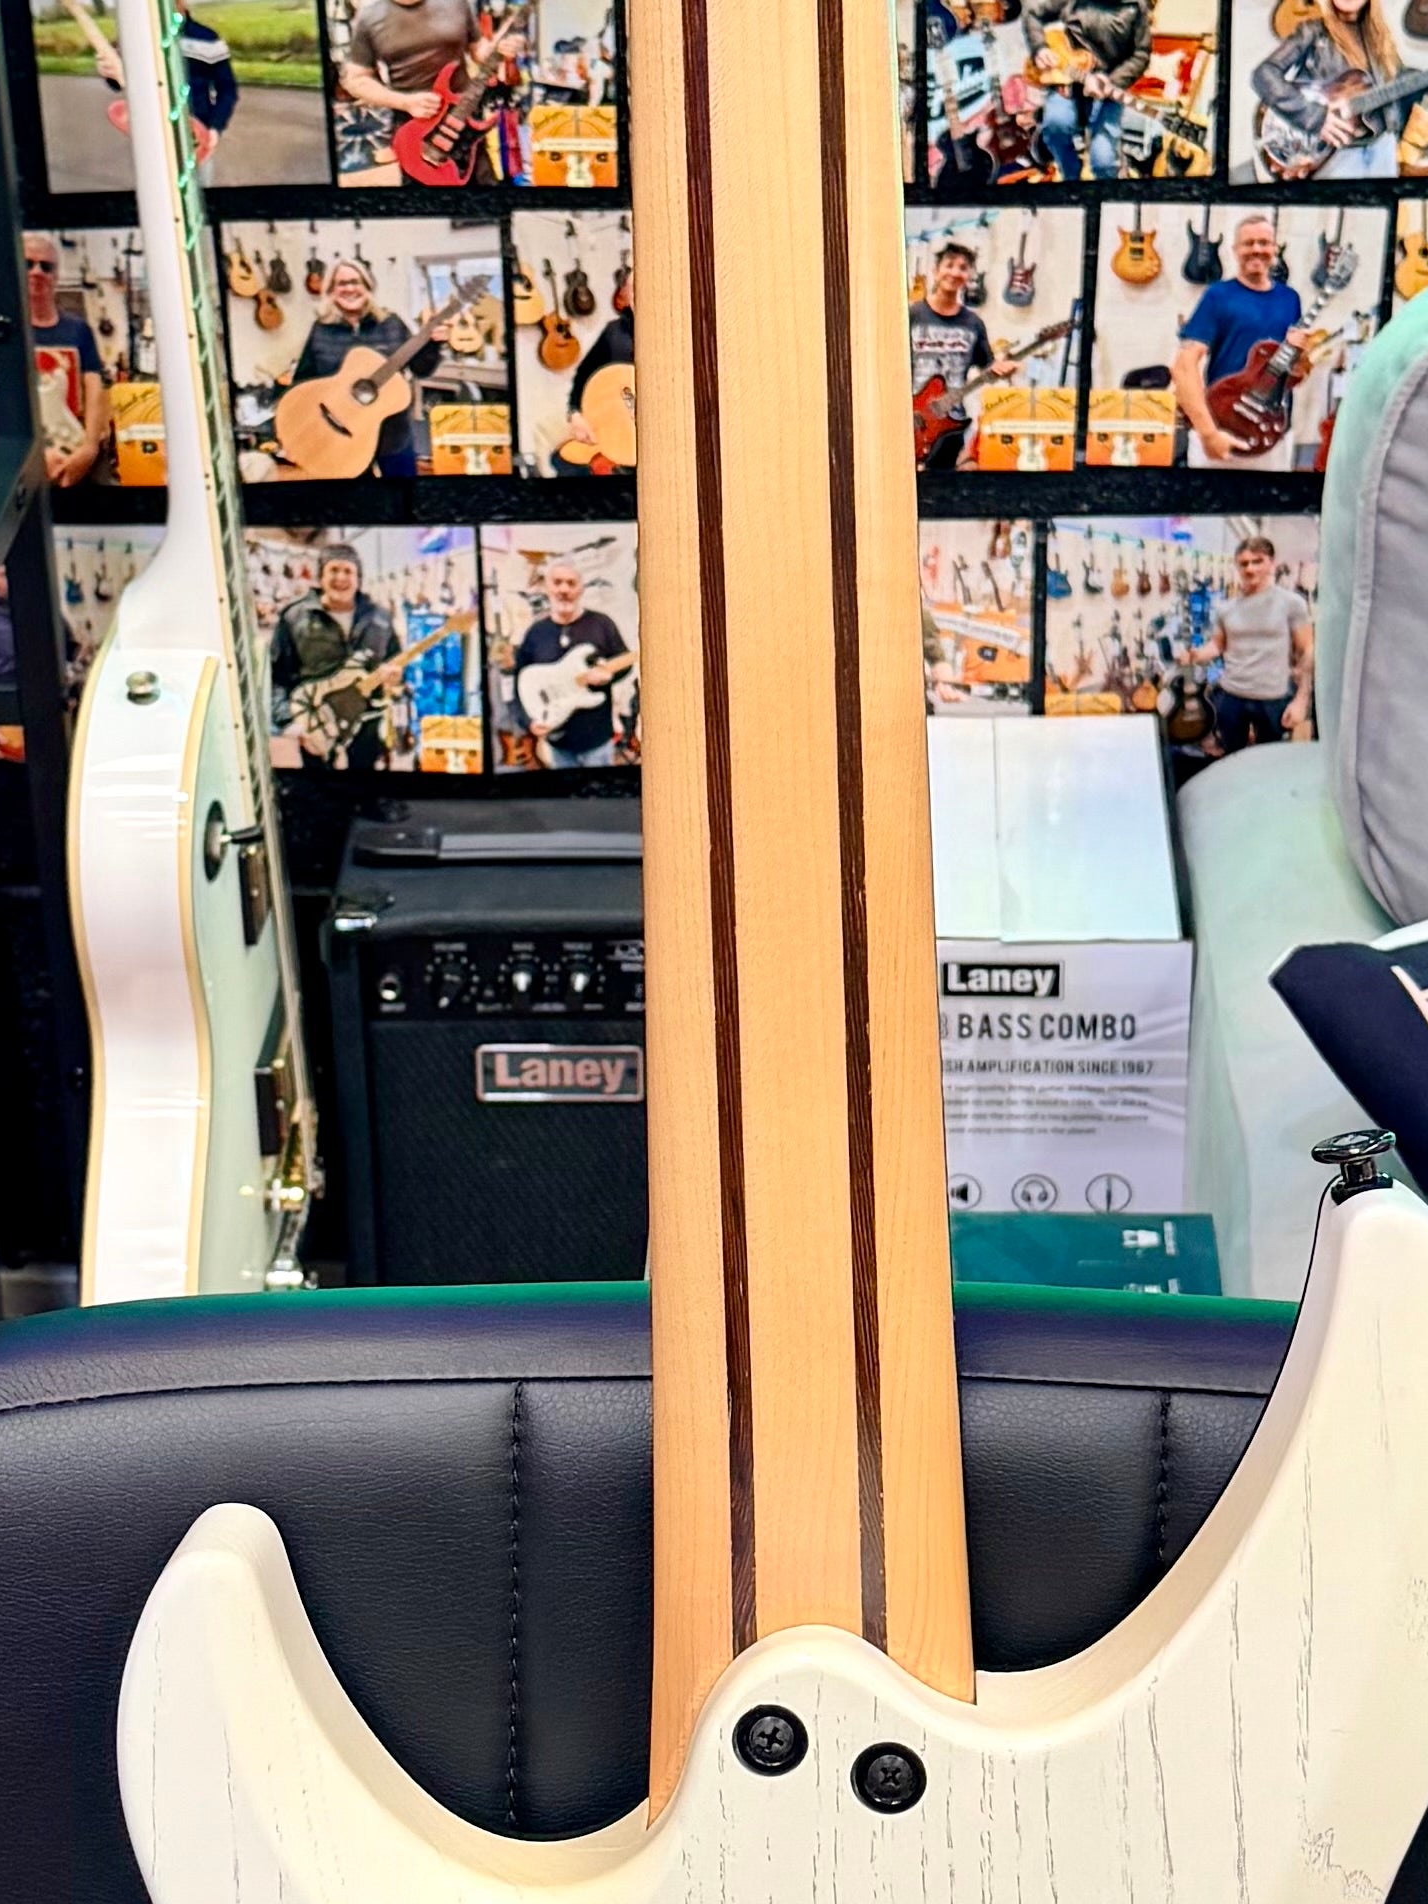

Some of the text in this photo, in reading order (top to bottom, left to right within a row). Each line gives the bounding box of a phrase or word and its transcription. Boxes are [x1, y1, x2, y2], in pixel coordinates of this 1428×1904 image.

[946, 962, 1058, 997] Laney
[957, 1013, 1033, 1040] BASS
[1039, 1013, 1137, 1041] COMBO
[493, 1052, 627, 1094] Laney
[967, 1059, 1074, 1074] AMPLIFICATION
[1077, 1060, 1118, 1075] SINCE
